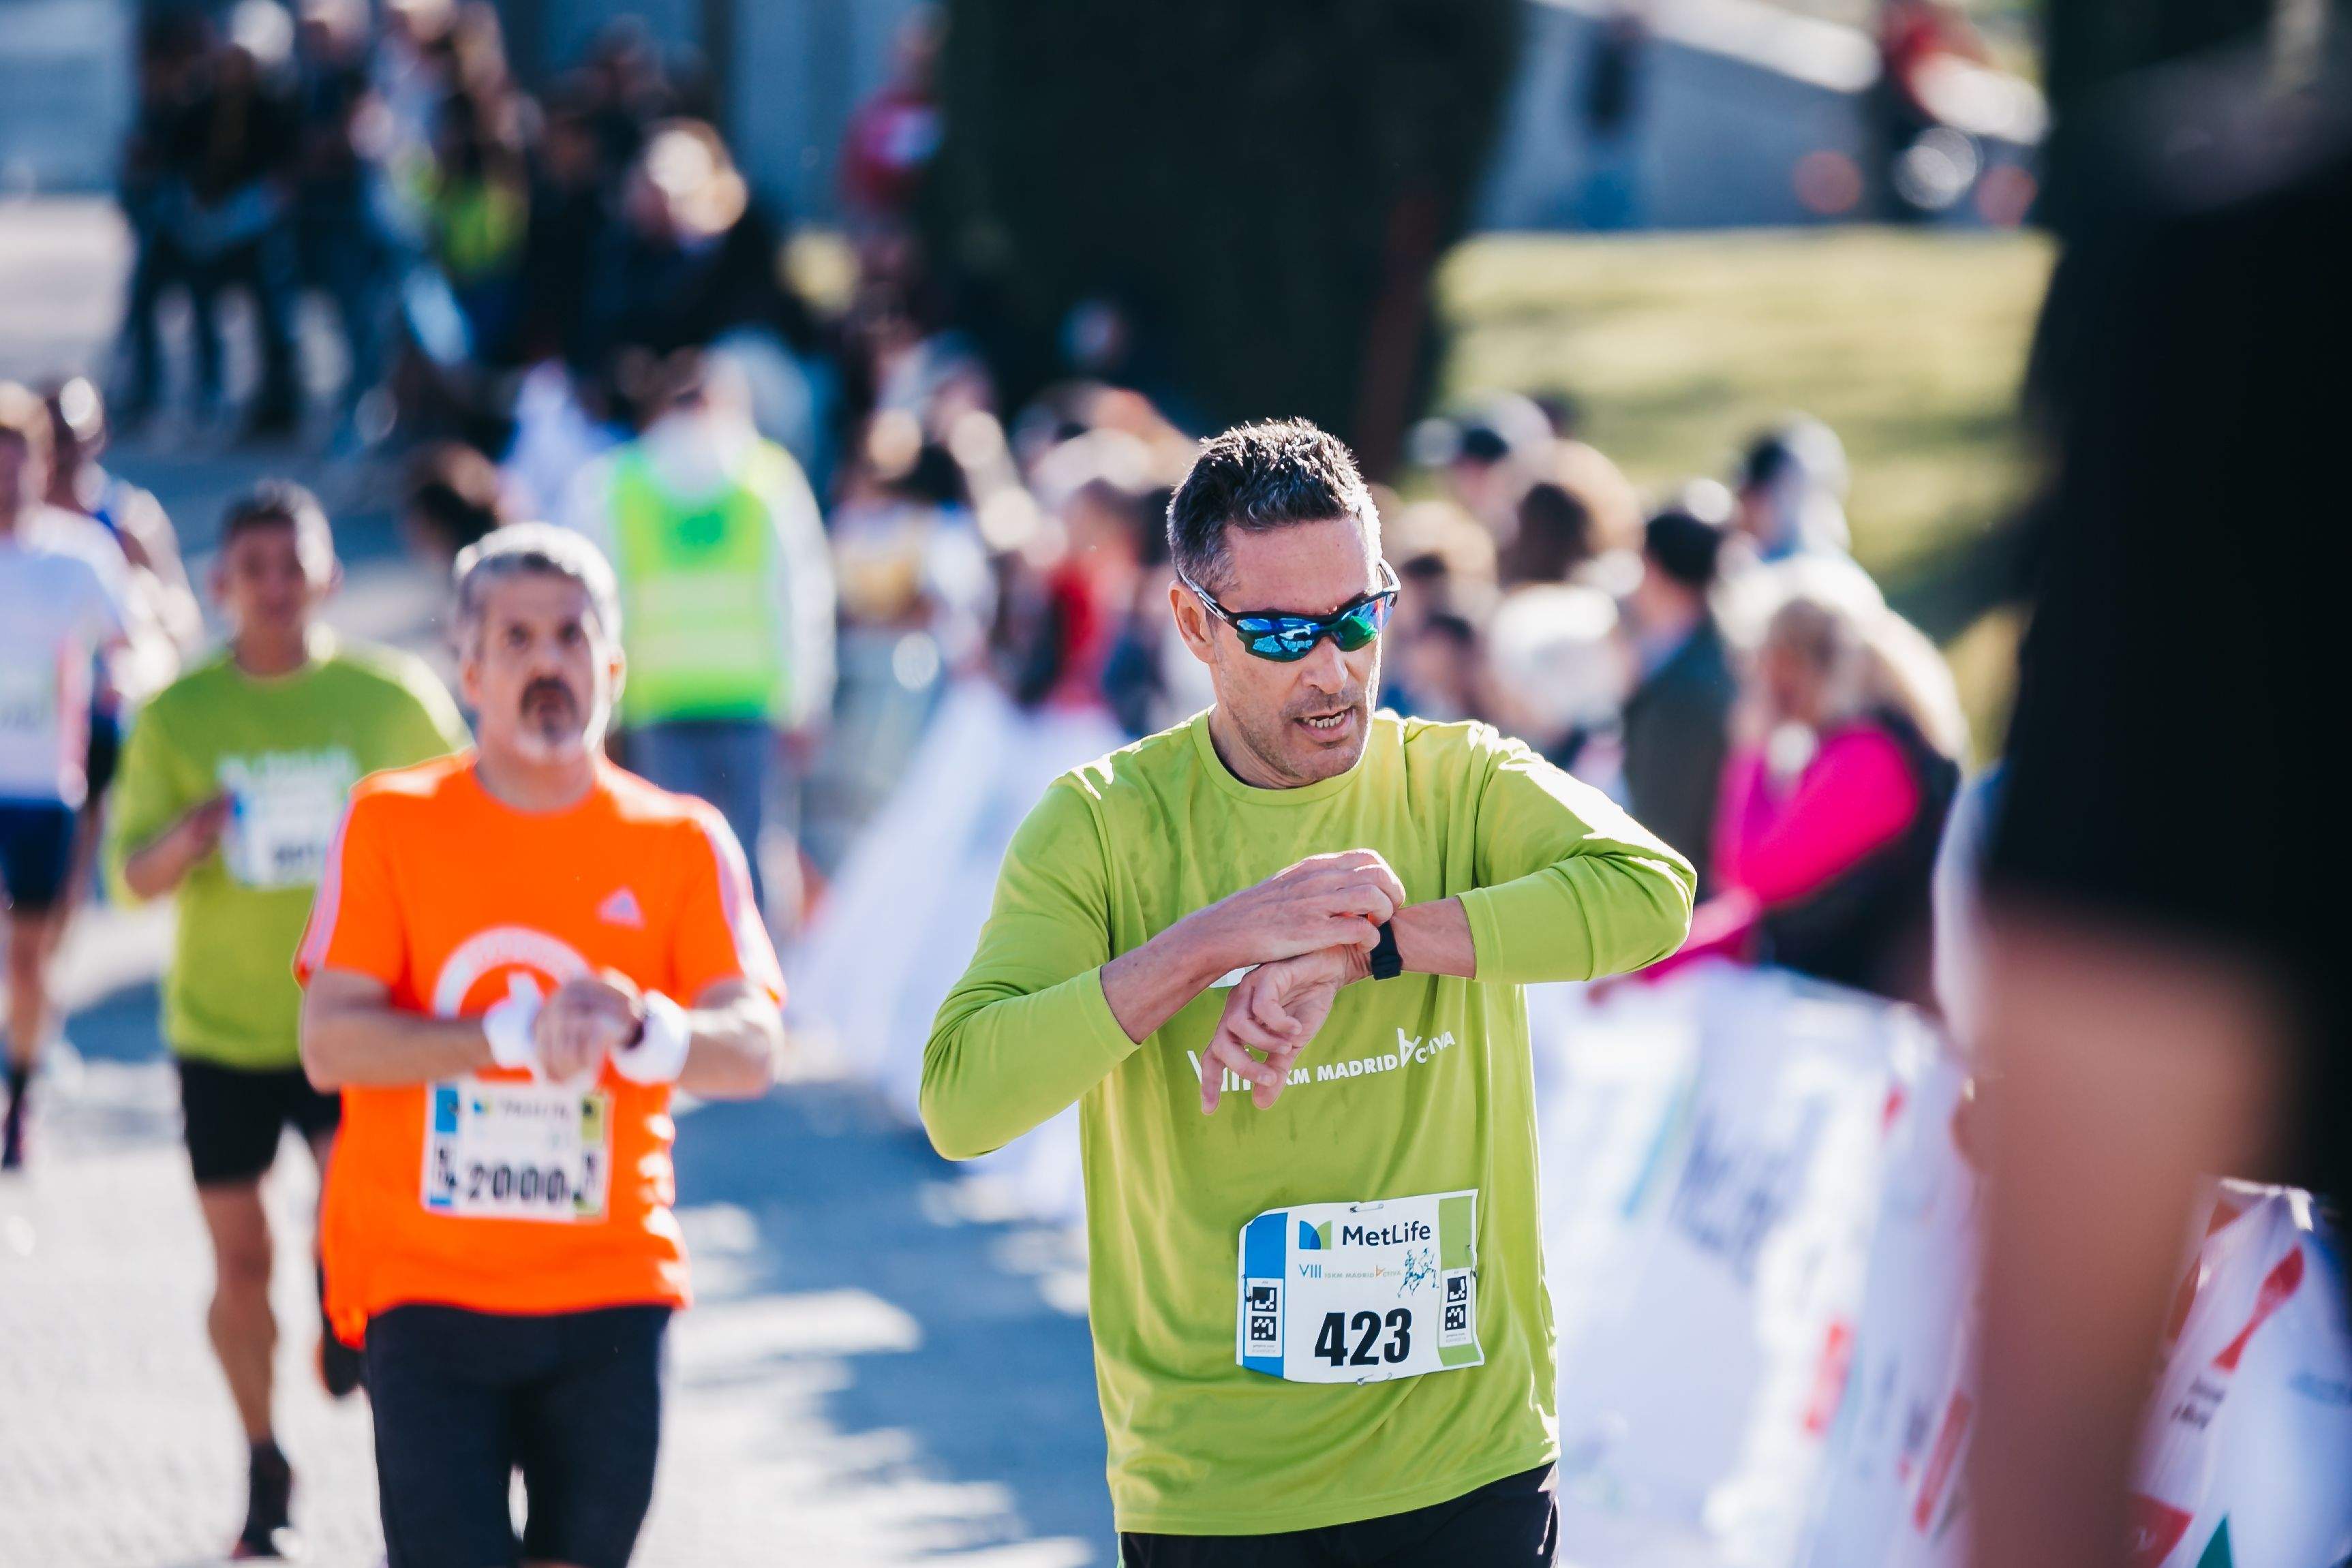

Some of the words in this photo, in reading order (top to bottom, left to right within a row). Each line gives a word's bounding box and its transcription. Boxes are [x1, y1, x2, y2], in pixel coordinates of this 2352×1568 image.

[1342, 1220, 1431, 1246] MetLife
[1298, 1264, 1322, 1278] VIII
[1314, 1308, 1412, 1367] 423
